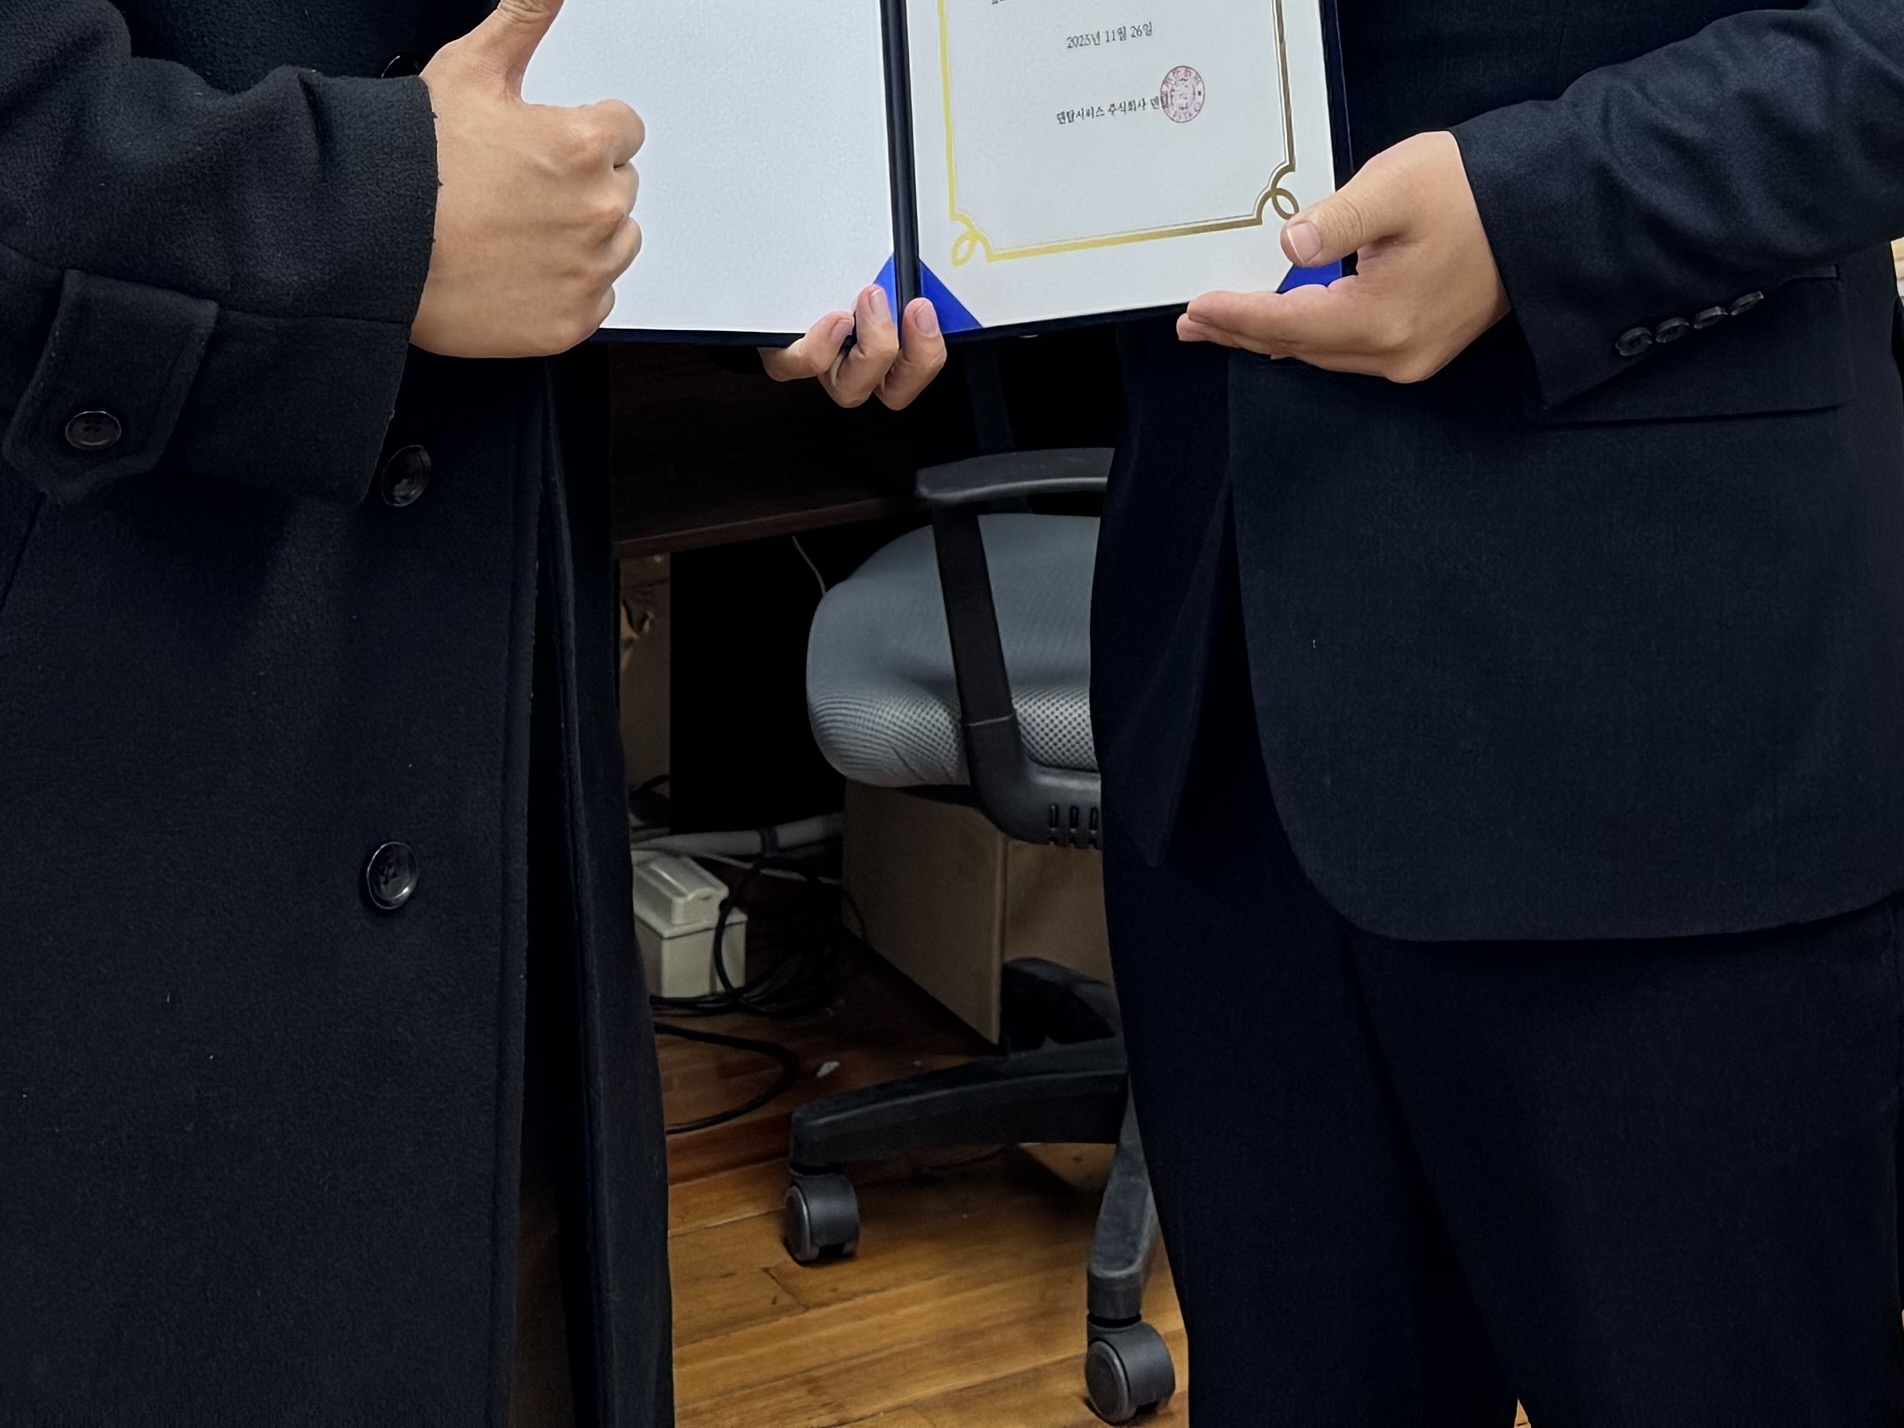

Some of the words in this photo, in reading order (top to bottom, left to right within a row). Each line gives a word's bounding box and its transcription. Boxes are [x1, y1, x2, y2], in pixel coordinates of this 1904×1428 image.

[1105, 25, 1127, 43] 11월
[1130, 21, 1152, 38] 26일
[1108, 97, 1146, 116] 주식회사
